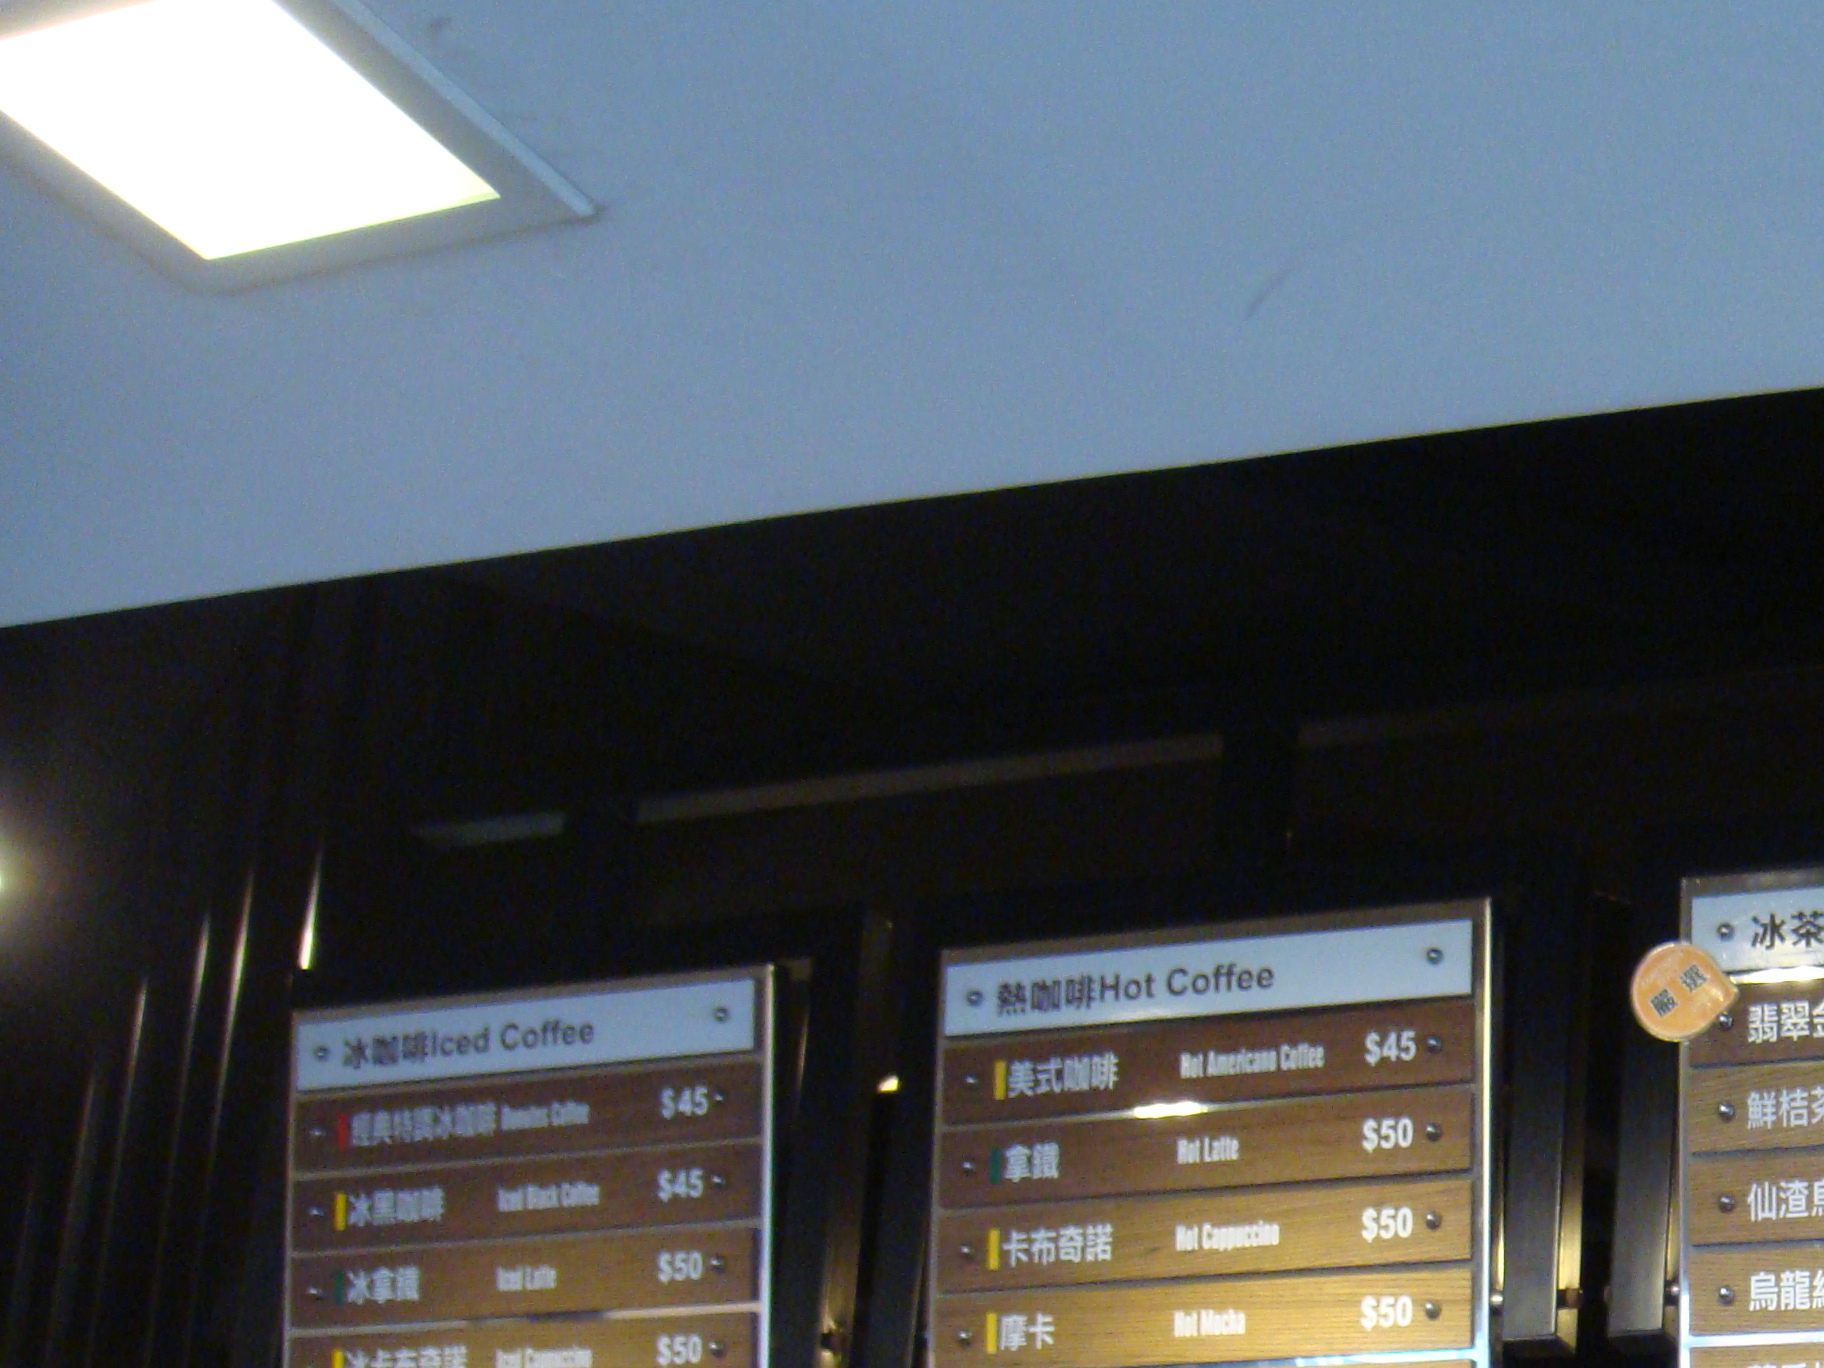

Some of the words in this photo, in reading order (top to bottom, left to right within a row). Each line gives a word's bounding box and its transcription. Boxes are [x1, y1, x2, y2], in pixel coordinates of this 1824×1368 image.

[1166, 963, 1274, 996] Coffee
[500, 1019, 593, 1051] Coffee
[1009, 1052, 1118, 1096] 美式咖啡
[1365, 1030, 1416, 1065] $45
[662, 1086, 708, 1119] $45
[1362, 1118, 1413, 1151] $50
[658, 1169, 703, 1202] $45
[1003, 1223, 1112, 1266] 卡布奇諾
[1361, 1207, 1413, 1242] $50
[658, 1251, 703, 1283] $50
[1361, 1295, 1412, 1330] $50
[656, 1334, 702, 1366] $50
